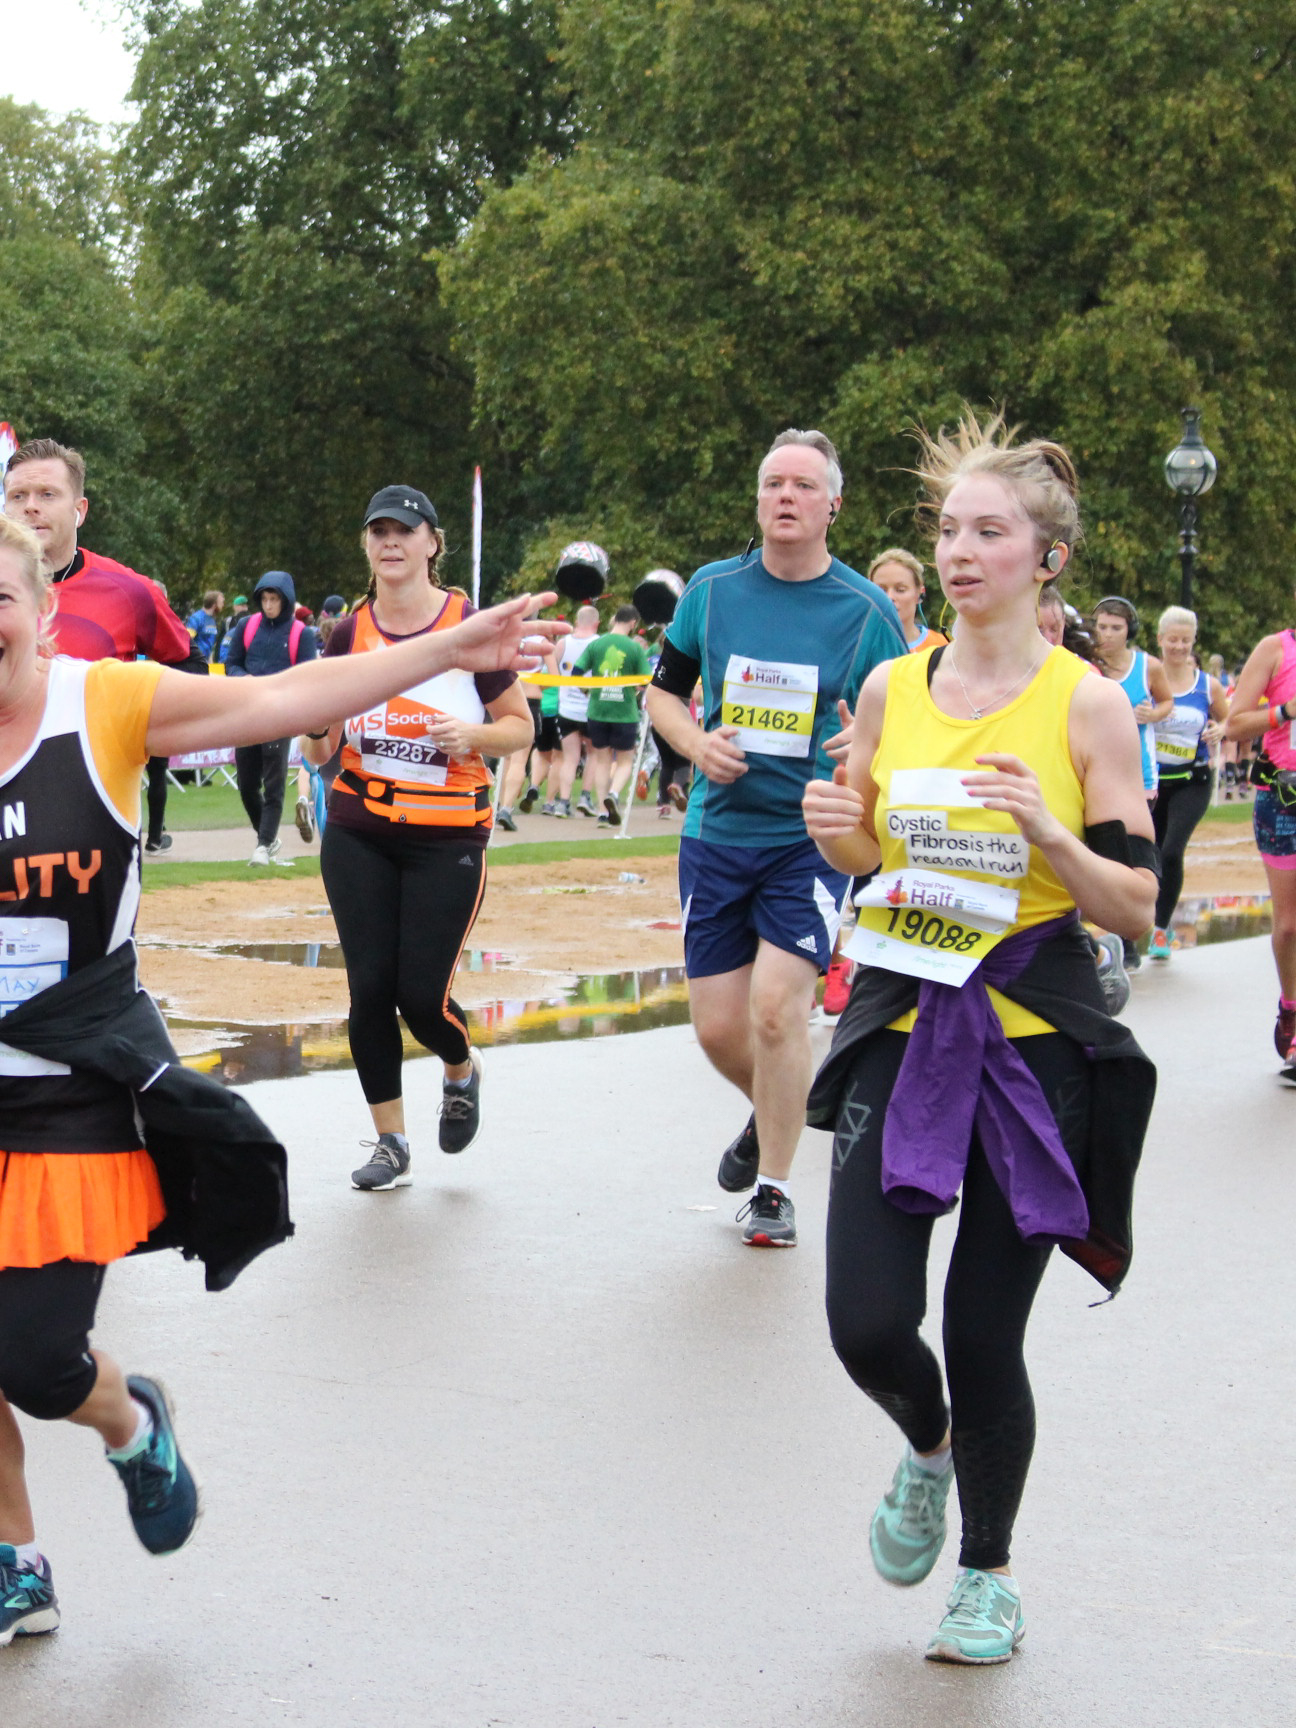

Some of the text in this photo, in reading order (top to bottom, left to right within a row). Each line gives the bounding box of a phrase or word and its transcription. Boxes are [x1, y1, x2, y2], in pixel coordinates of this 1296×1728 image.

[755, 673, 781, 685] Half
[349, 713, 384, 735] MS
[732, 706, 799, 731] 21462
[374, 741, 437, 763] 23287
[889, 815, 942, 834] Cystic
[985, 838, 1022, 855] the
[912, 855, 977, 868] reason
[989, 861, 1024, 873] run
[913, 880, 955, 892] Royal Parks
[911, 888, 953, 907] Half
[887, 907, 982, 952] 19088
